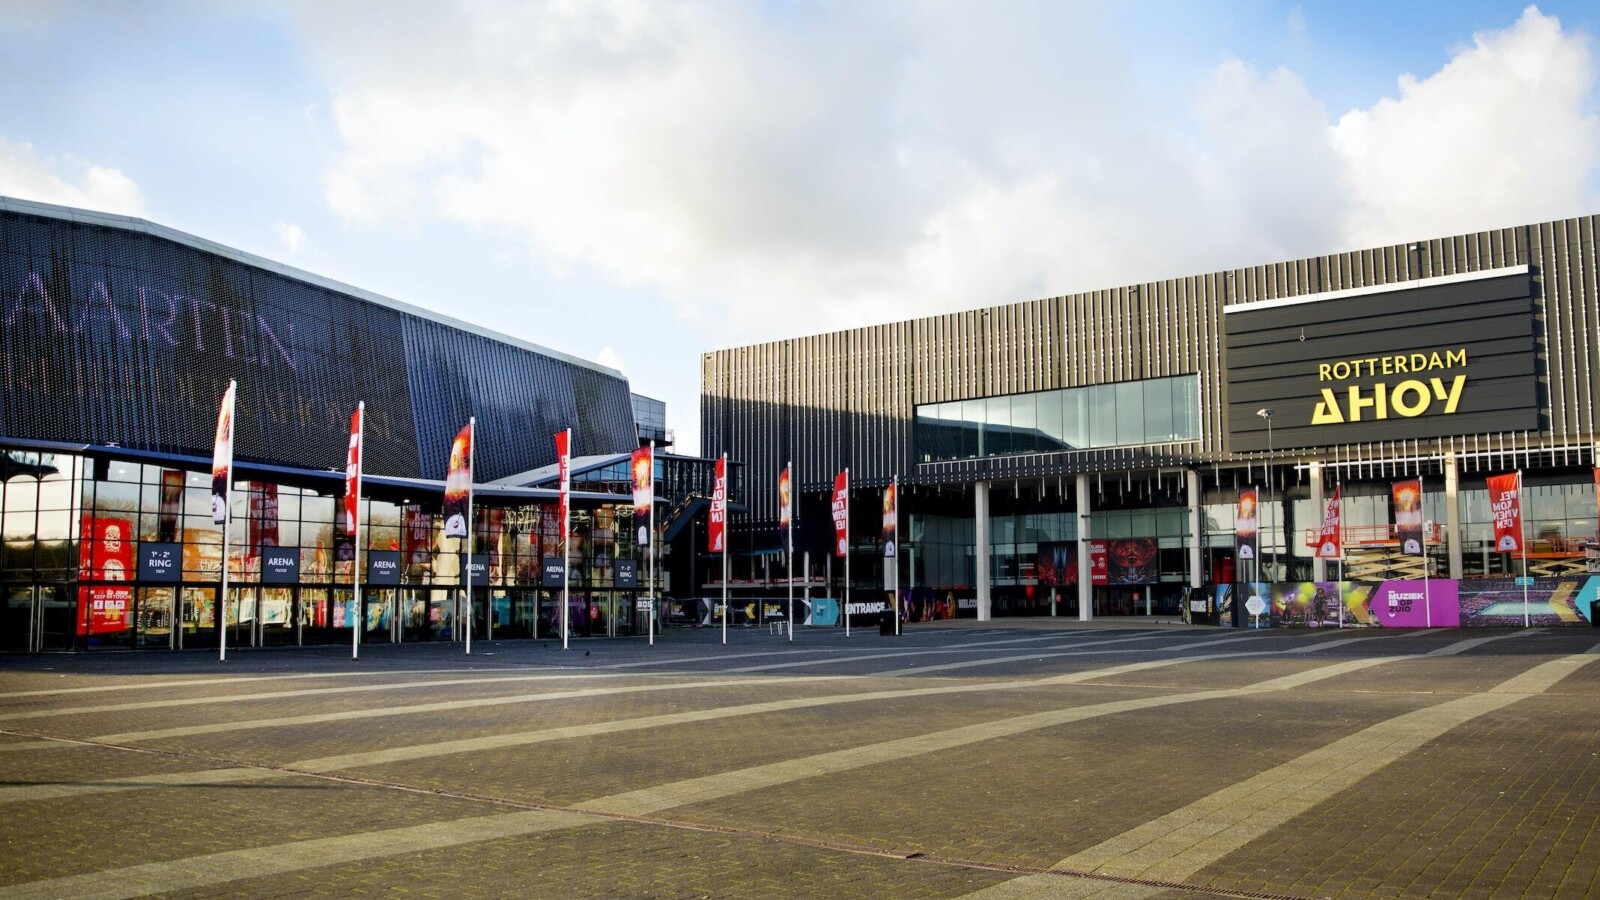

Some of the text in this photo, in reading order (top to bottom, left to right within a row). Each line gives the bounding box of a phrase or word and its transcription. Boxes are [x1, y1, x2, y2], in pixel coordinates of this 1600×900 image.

[1319, 348, 1467, 382] ROTTERDAM
[1311, 375, 1467, 425] AHOY
[149, 559, 172, 568] RING
[268, 557, 294, 566] ARENA
[373, 561, 397, 569] ARENA
[546, 565, 564, 573] ARENA
[1388, 592, 1424, 600] MUZIEK
[845, 601, 886, 615] ENTRANCE
